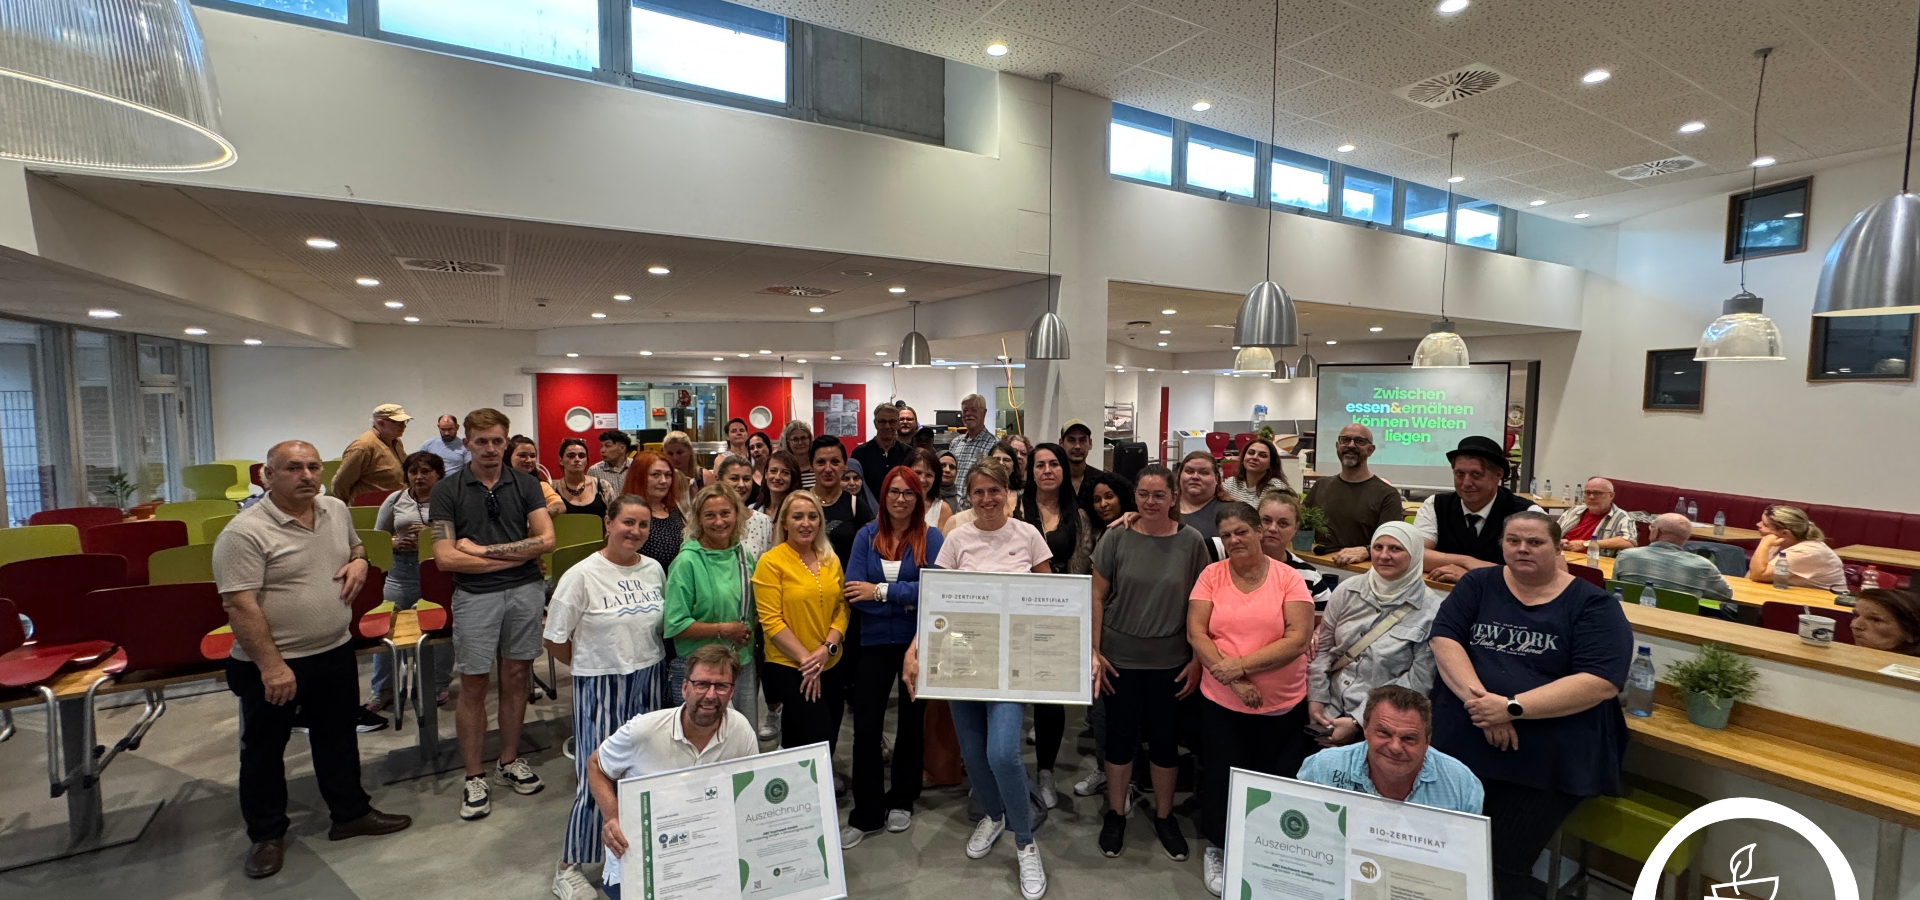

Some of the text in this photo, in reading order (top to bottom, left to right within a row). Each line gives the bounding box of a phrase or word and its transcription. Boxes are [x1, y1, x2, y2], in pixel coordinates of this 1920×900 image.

[1373, 387, 1446, 401] Zwischen
[1352, 415, 1467, 430] können Welten
[1385, 428, 1431, 446] liegen
[617, 579, 643, 592] SUR
[603, 590, 662, 609] LA PLAGE
[941, 593, 990, 601] BIO-ZERTIFIKAT
[1021, 596, 1069, 604] BIO-ZERTIFIKAT
[1507, 628, 1559, 651] YORK
[1510, 640, 1548, 655] Mind
[745, 802, 811, 823] Auszeichnung
[1369, 826, 1447, 849] BIO-ZERTIFIKAT
[1254, 835, 1335, 865] Auszeichnung
